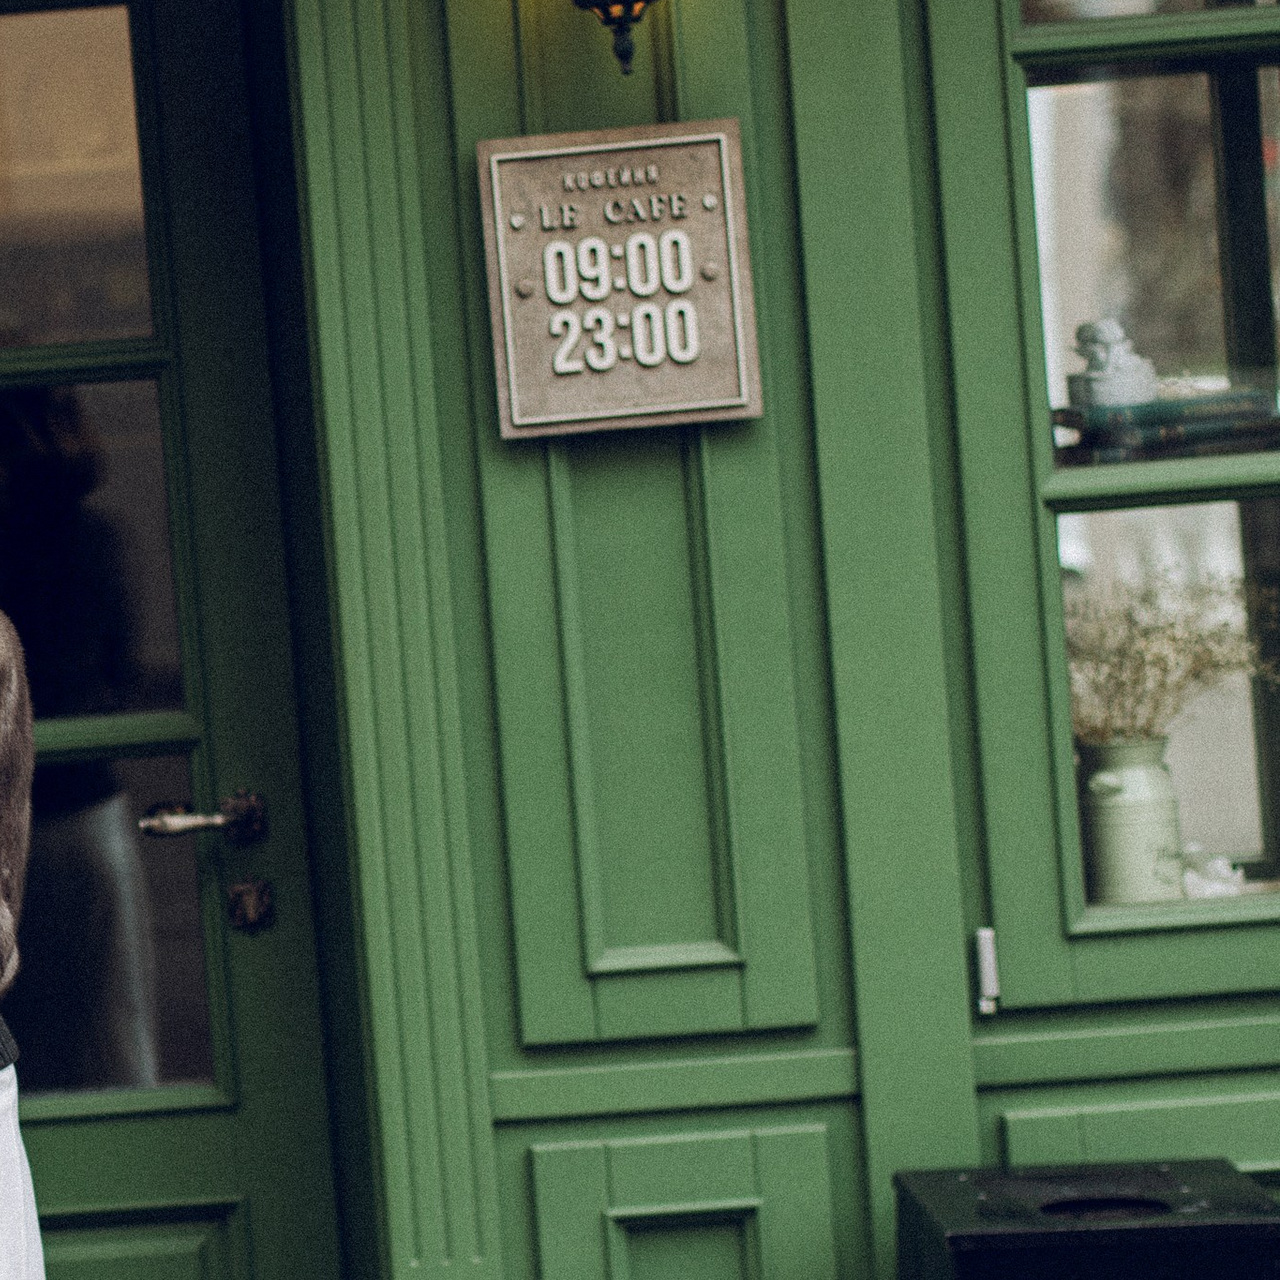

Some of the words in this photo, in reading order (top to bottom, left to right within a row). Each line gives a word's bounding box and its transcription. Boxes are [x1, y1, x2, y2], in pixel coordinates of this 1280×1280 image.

[540, 204, 578, 231] LE
[603, 193, 689, 224] CAFE
[543, 228, 696, 305] 09:00
[549, 298, 701, 376] 23:00
